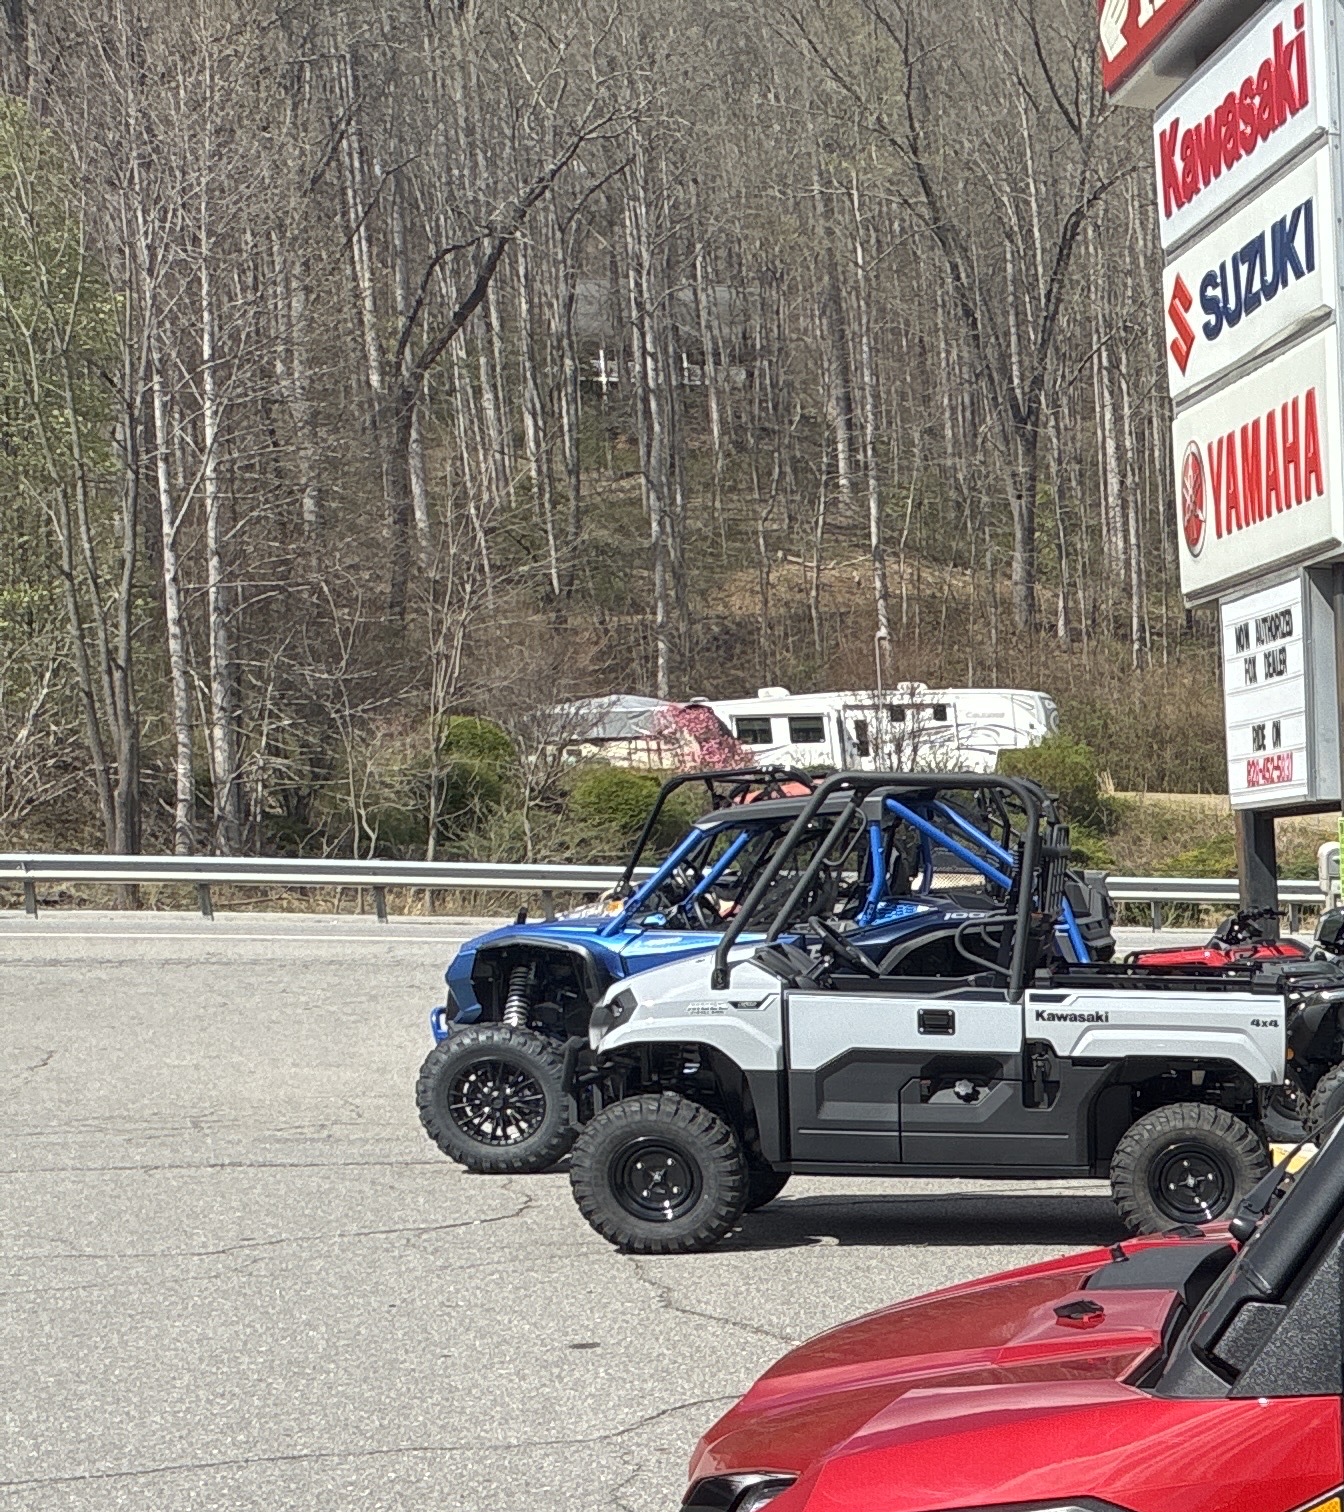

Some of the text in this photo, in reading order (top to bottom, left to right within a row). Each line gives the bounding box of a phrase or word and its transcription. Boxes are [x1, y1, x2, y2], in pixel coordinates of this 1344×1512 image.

[1159, 5, 1310, 219] Kawasaki
[1199, 197, 1316, 342] SUZUKI
[1207, 387, 1324, 540] YAMAHA
[1234, 608, 1294, 655] NOW AUTHORIZED
[1243, 645, 1288, 686] FOX DEALER
[1035, 1010, 1110, 1024] Kawasaki
[1251, 1019, 1280, 1029] 4x4
